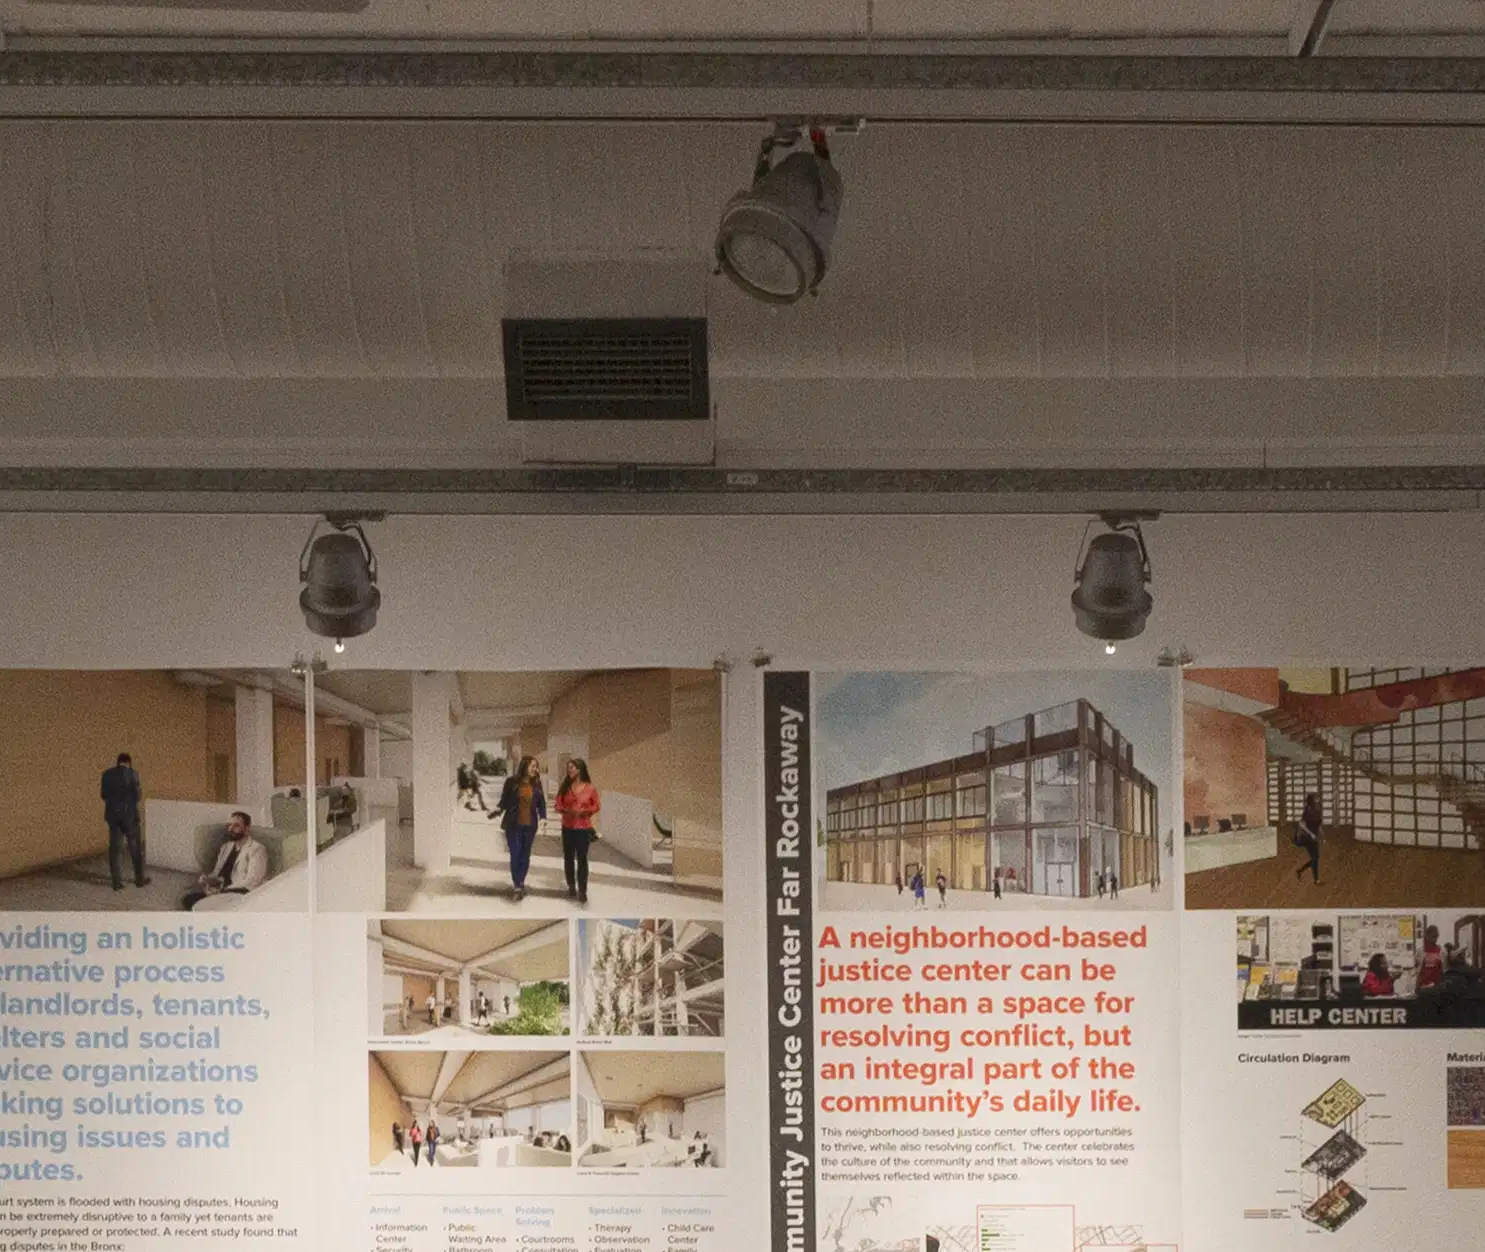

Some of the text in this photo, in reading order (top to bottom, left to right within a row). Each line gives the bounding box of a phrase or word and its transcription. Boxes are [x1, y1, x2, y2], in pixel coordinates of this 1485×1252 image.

[776, 706, 803, 857] Rockaway
[777, 867, 799, 915] Far
[97, 933, 131, 948] an
[143, 927, 244, 949] holistic
[819, 925, 1146, 954] A neighborhood-based
[115, 966, 224, 991] process
[778, 925, 801, 1027] Center
[1272, 1009, 1405, 1024] HELP CENTER
[821, 1024, 1131, 1052] resolving conflict, but
[1238, 1053, 1350, 1064] Circulation Diagram
[63, 1058, 258, 1087] organizations
[779, 1036, 803, 1141] Justice
[1014, 1089, 1080, 1118] daily
[1091, 1089, 1140, 1111] life.
[17, 1198, 54, 1207] system
[113, 1198, 135, 1206] with
[139, 1198, 180, 1208] housing
[184, 1198, 231, 1208] disputes.
[235, 1198, 278, 1208] Housing
[375, 1224, 427, 1233] Information
[521, 1236, 575, 1244] Courtrooms
[595, 1224, 631, 1234] Therapy
